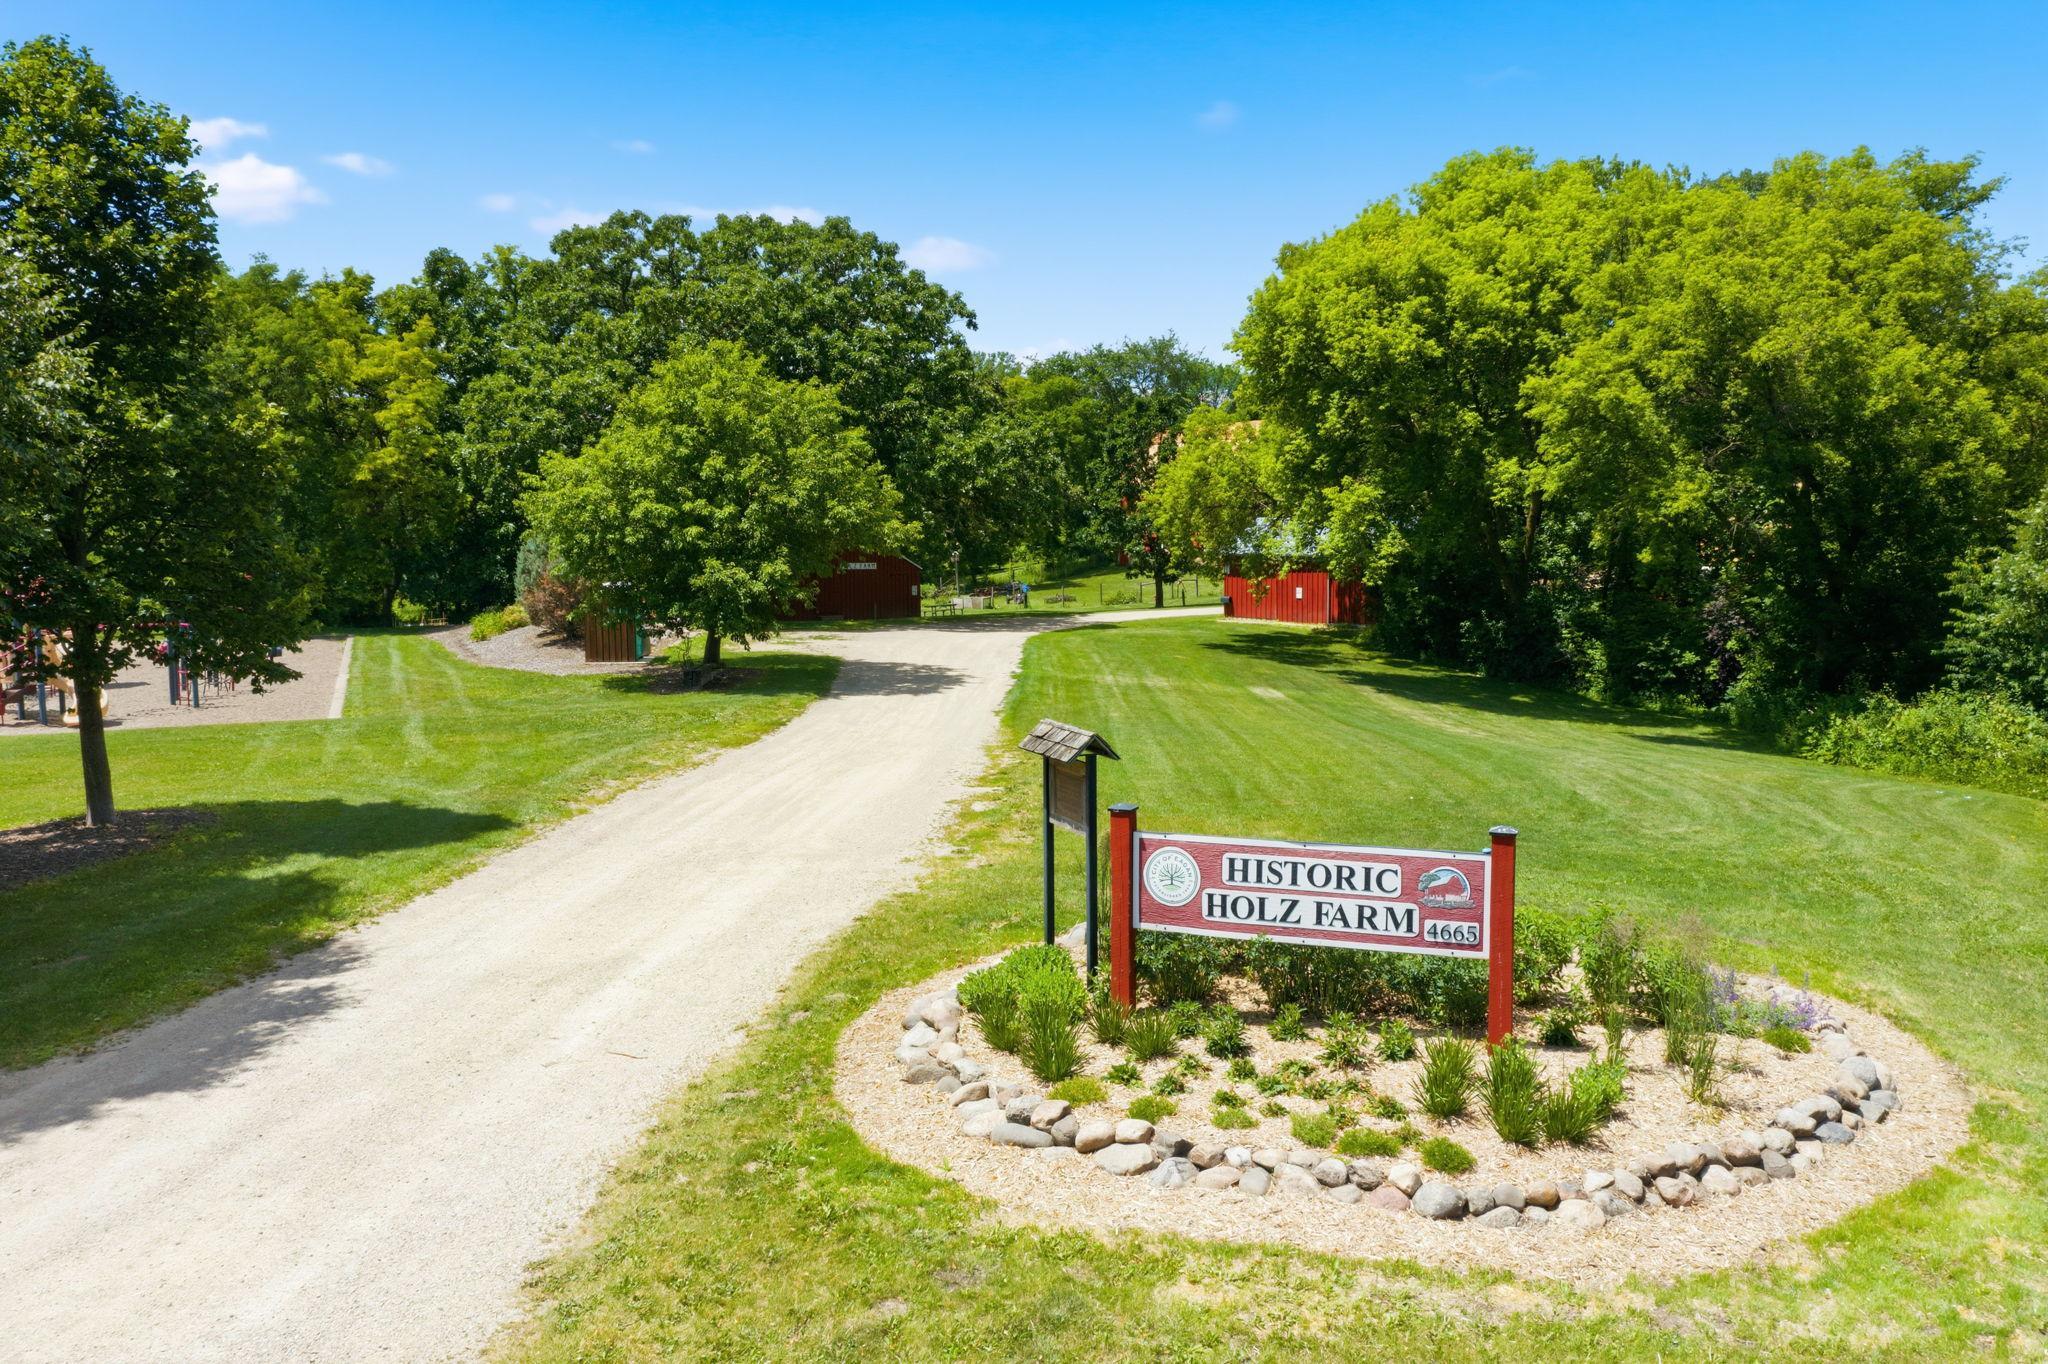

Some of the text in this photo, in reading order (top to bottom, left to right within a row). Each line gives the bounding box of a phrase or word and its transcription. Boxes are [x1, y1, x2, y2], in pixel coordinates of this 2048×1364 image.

[1152, 860, 1161, 875] CITY
[1226, 857, 1398, 893] HISTORIC
[1205, 892, 1417, 934] HOLZ FARM
[1427, 922, 1477, 942] 4665
